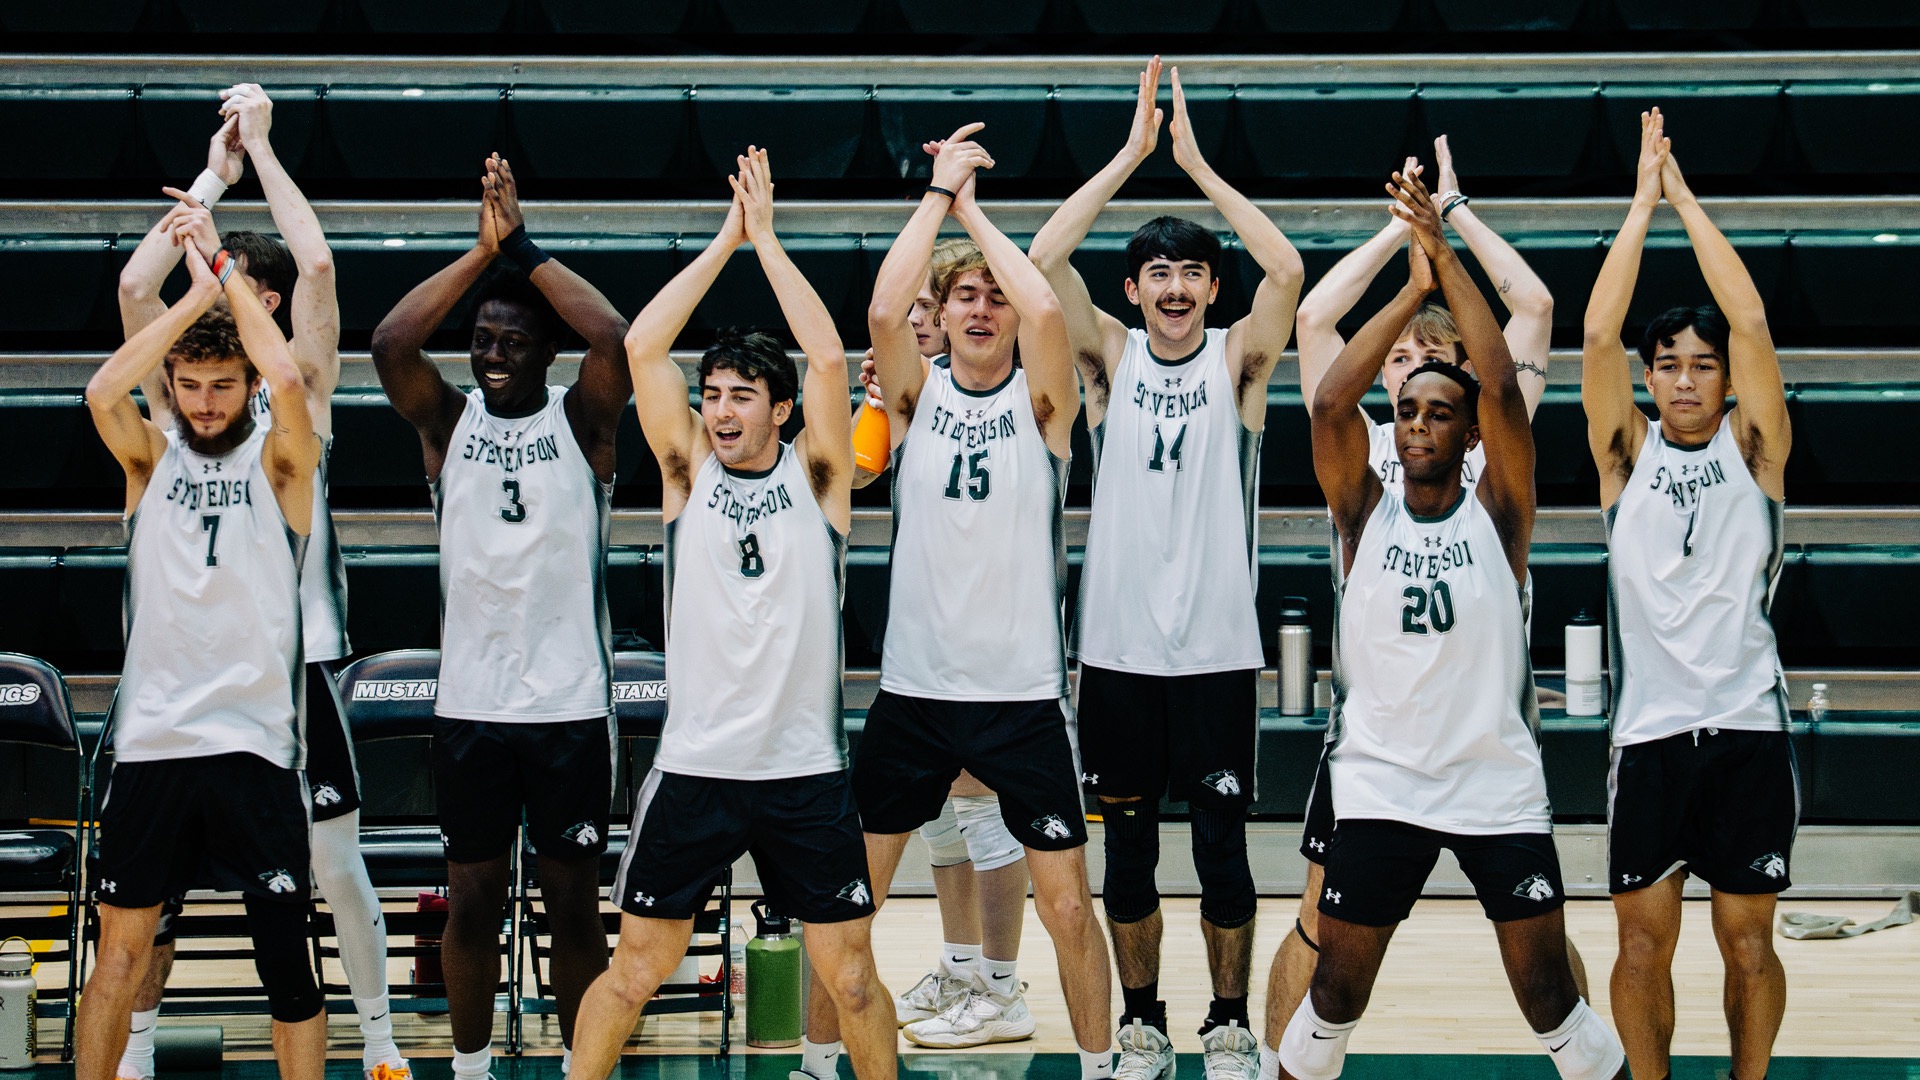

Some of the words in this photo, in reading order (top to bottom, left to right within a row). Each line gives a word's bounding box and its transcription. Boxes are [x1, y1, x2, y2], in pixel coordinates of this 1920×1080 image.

[942, 446, 992, 502] 15
[500, 478, 528, 524] 3
[201, 513, 223, 569] 7
[738, 531, 767, 580] 8
[1383, 540, 1474, 579] STEVESO
[1401, 578, 1457, 636] 20
